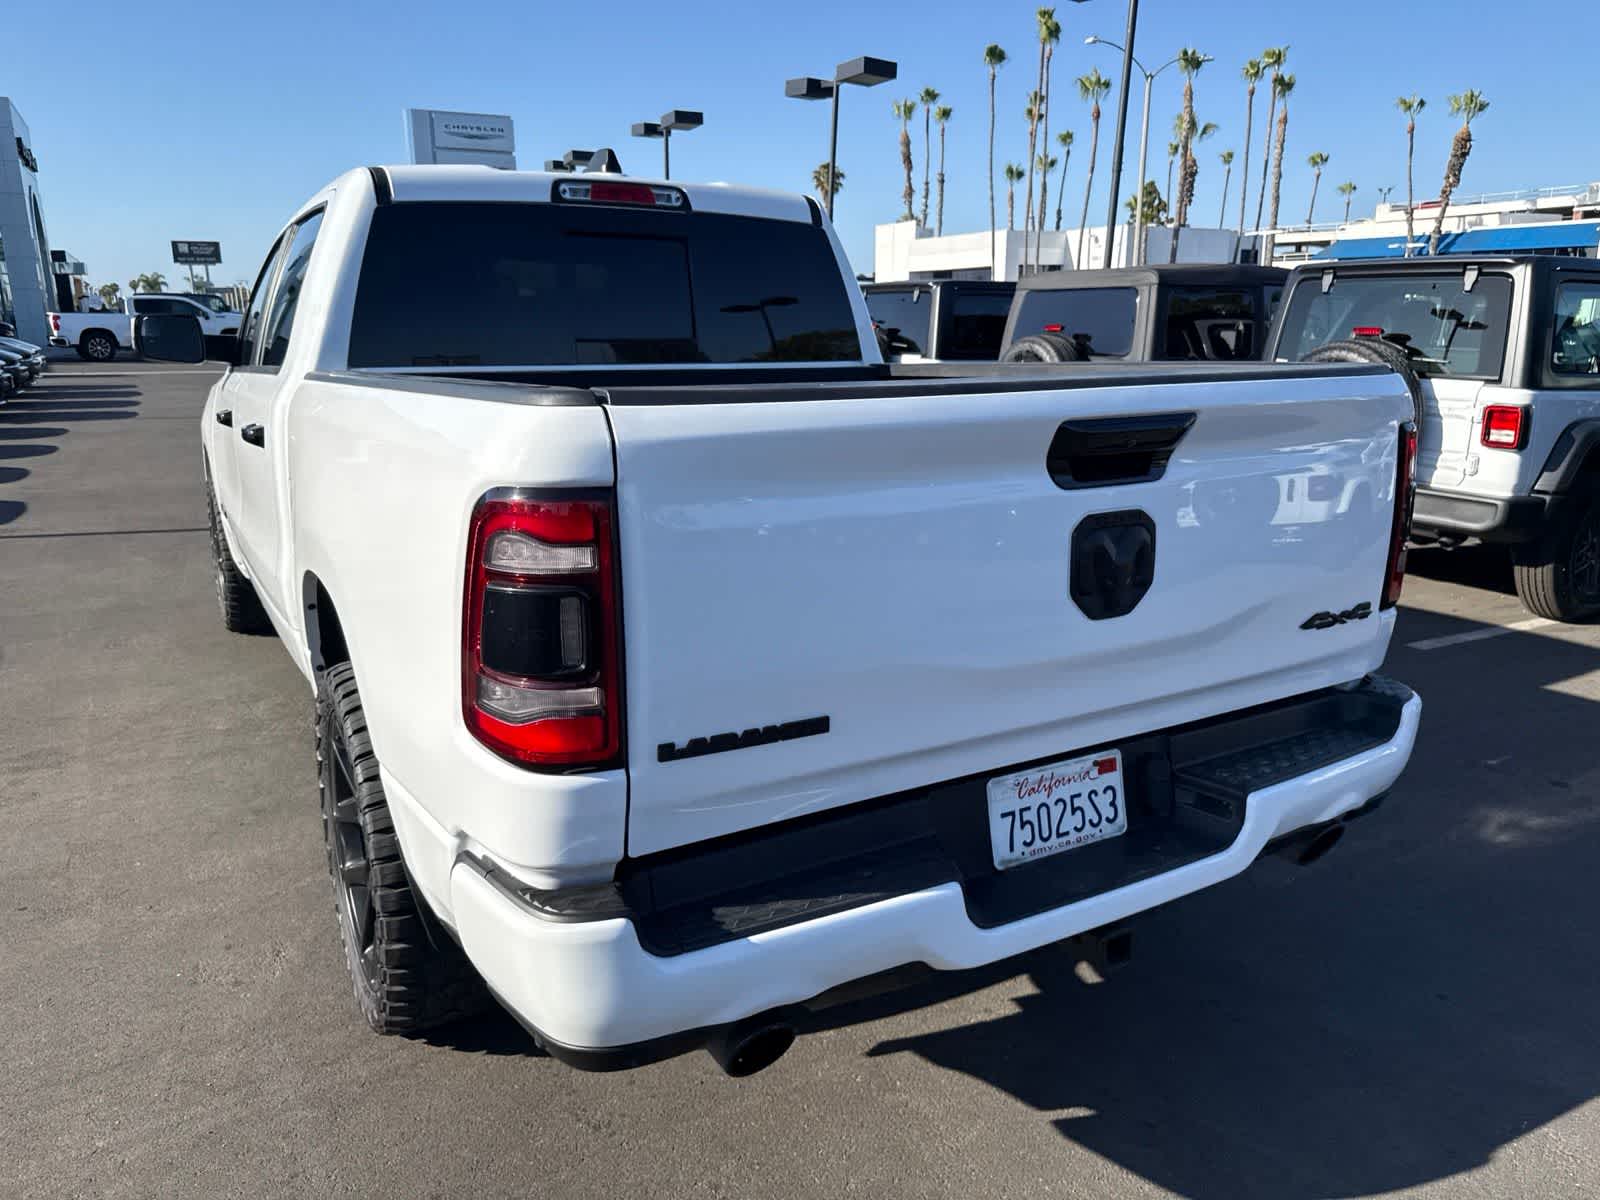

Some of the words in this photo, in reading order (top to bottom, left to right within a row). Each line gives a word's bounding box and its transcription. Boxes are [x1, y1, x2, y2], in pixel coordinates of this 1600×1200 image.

[444, 123, 505, 134] CHRYSLER
[656, 715, 831, 763] LARAM
[1014, 768, 1098, 800] California
[1000, 784, 1119, 853] 75025S3
[1028, 831, 1097, 856] dmv.ca.gov
